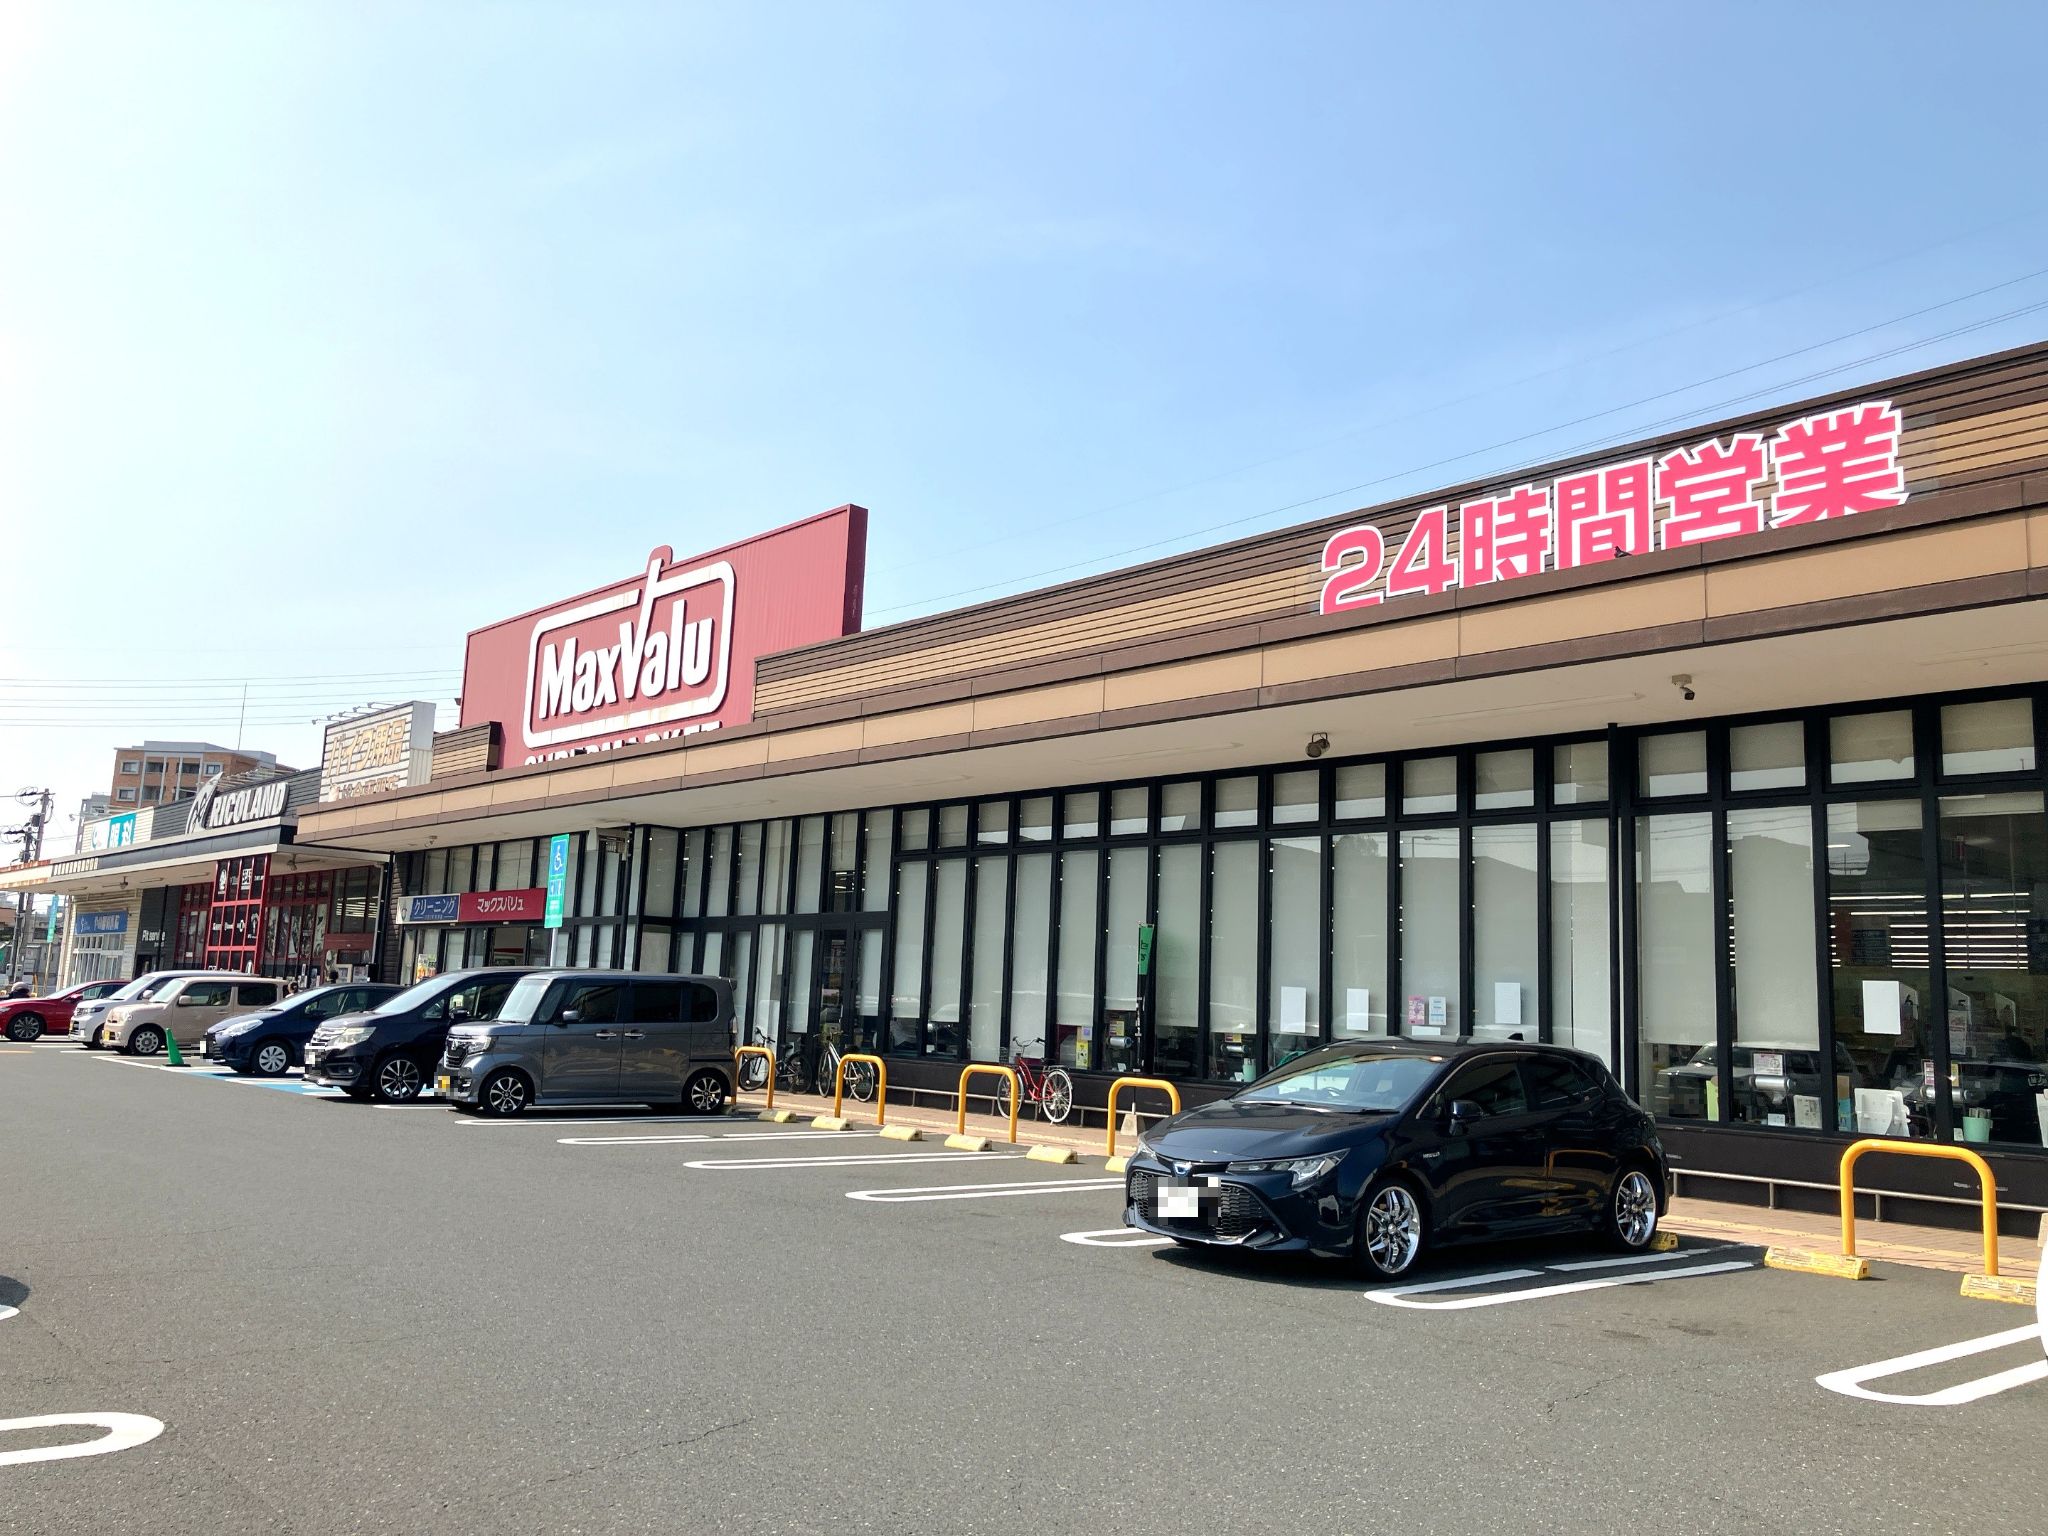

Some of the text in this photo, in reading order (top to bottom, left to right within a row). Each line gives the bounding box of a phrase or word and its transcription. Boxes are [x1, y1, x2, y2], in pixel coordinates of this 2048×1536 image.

[1320, 401, 1910, 615] 24時間営業
[538, 558, 715, 720] MaxValu
[326, 718, 407, 778] バイク用品
[209, 782, 288, 827] RICOLAND
[414, 896, 457, 916] クリーニング
[477, 895, 524, 912] マックスバリュ
